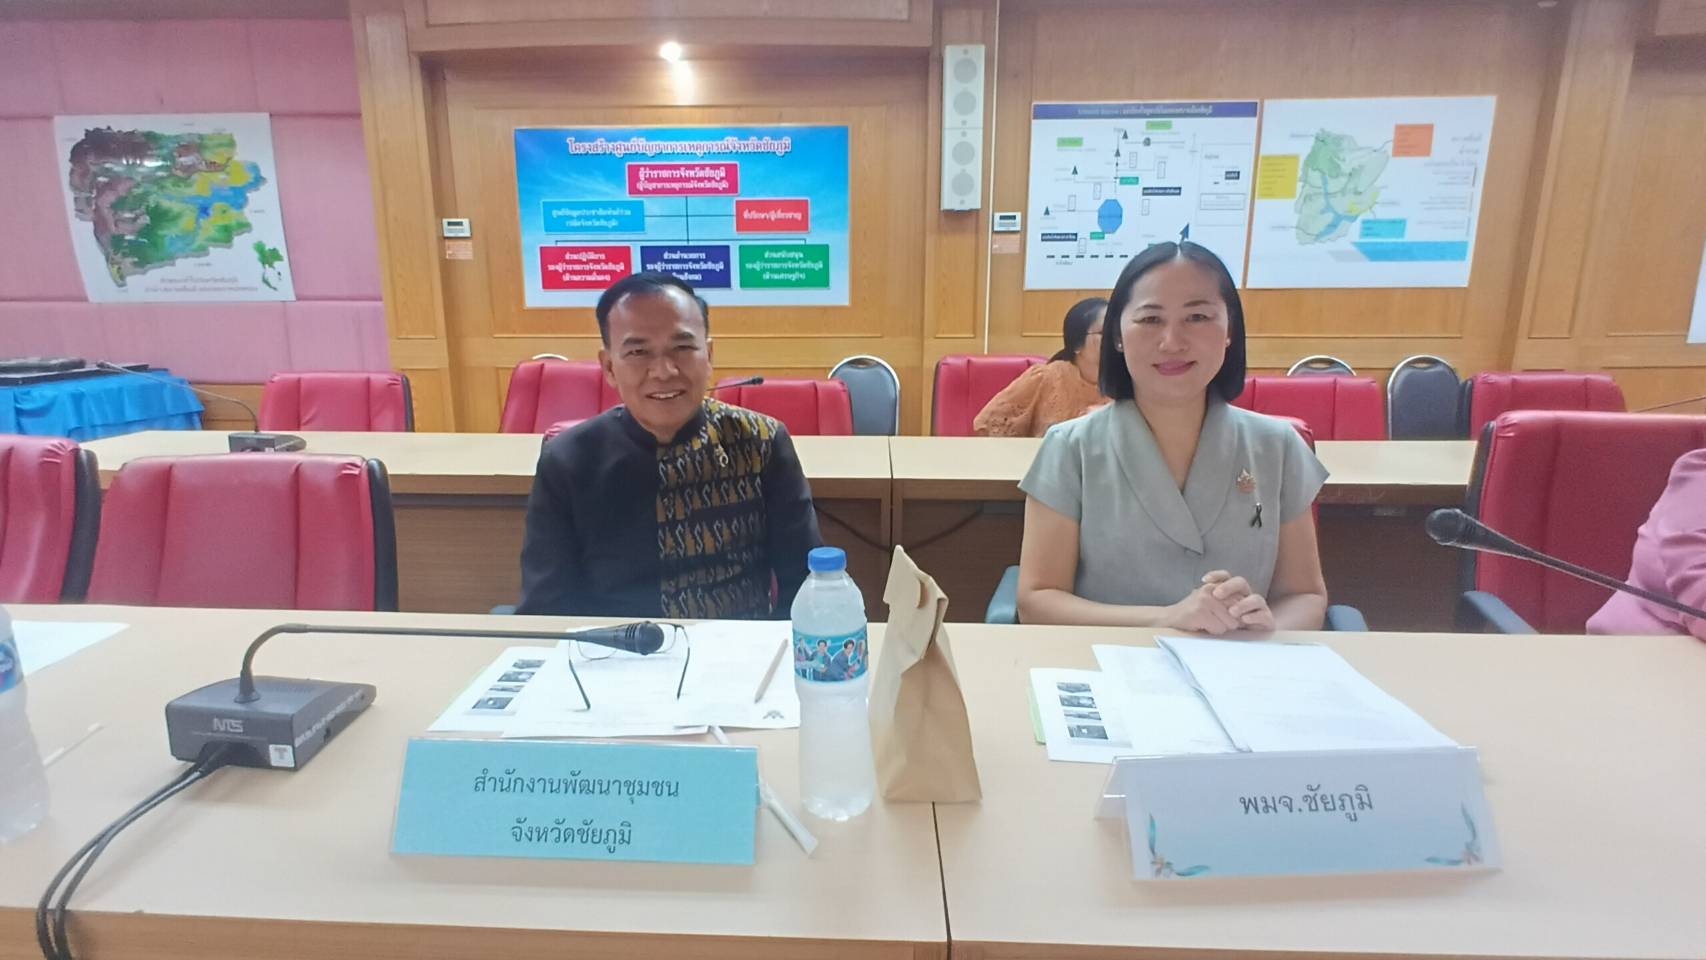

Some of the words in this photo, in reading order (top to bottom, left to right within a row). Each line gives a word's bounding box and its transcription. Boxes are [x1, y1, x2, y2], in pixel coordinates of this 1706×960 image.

[474, 769, 680, 804] สำนักงานพัฒนาชุมชน
[1239, 784, 1373, 822] พมจ.ชัยภูมิ
[511, 818, 632, 853] จังหวัดชัยภูมิ
